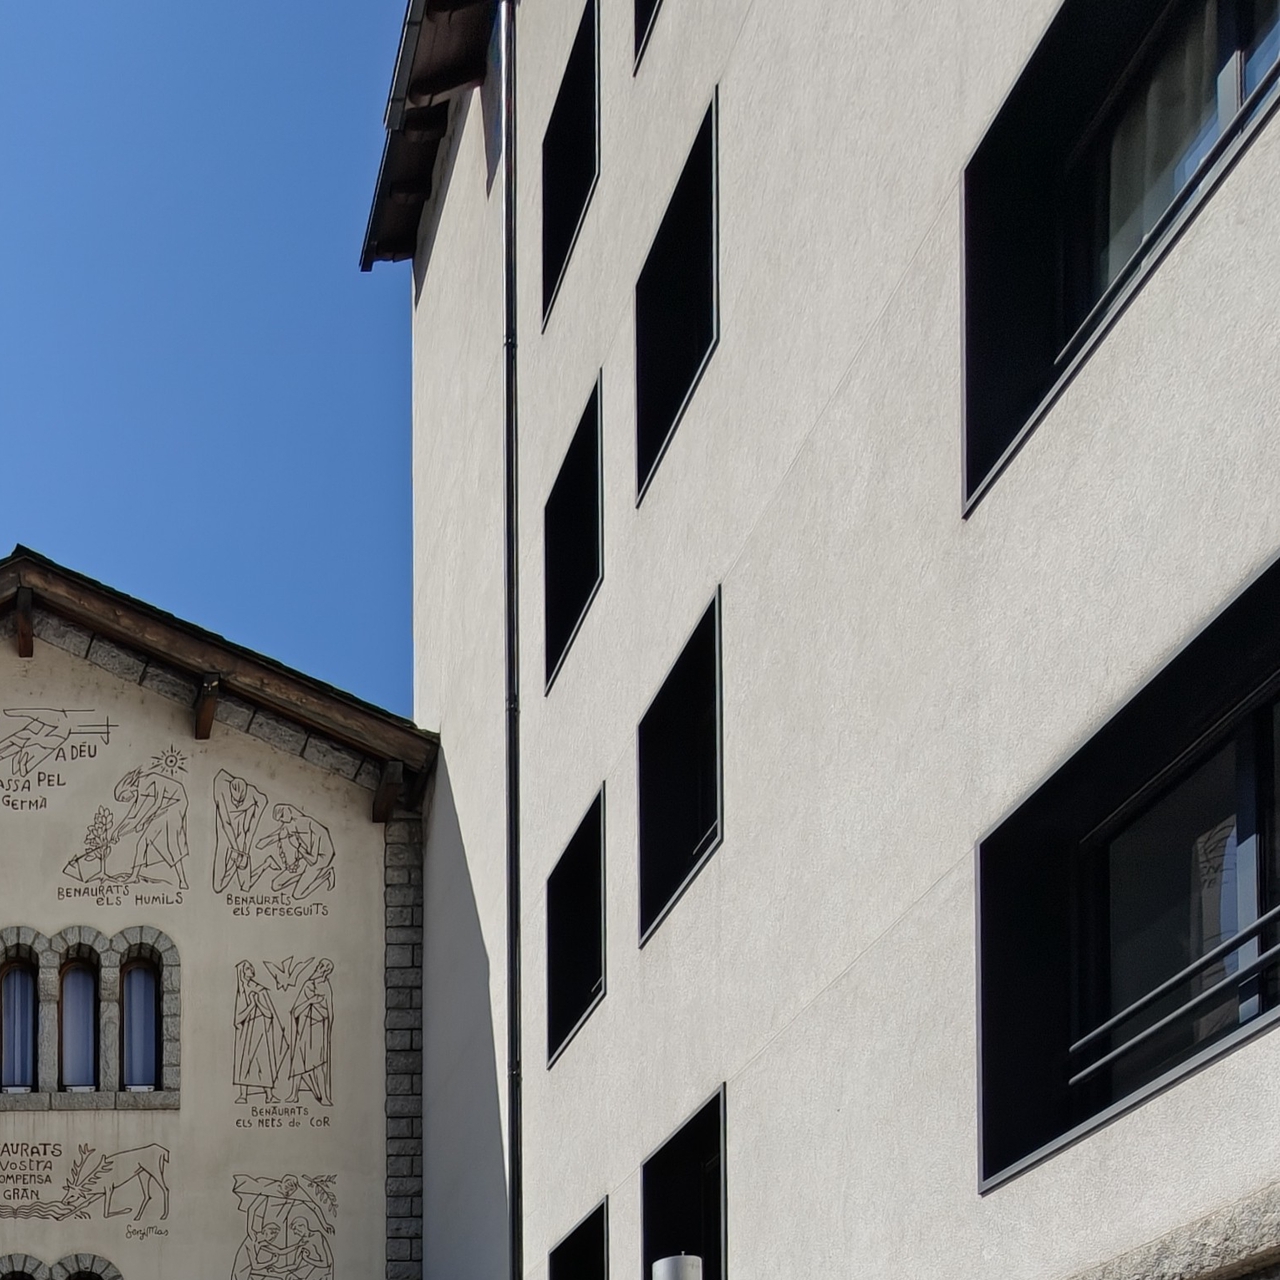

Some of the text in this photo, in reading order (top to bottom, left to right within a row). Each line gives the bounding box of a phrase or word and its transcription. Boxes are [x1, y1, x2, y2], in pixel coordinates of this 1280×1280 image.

[55, 747, 67, 762] A
[37, 771, 66, 787] PEL
[3, 1188, 40, 1200] GRAN
